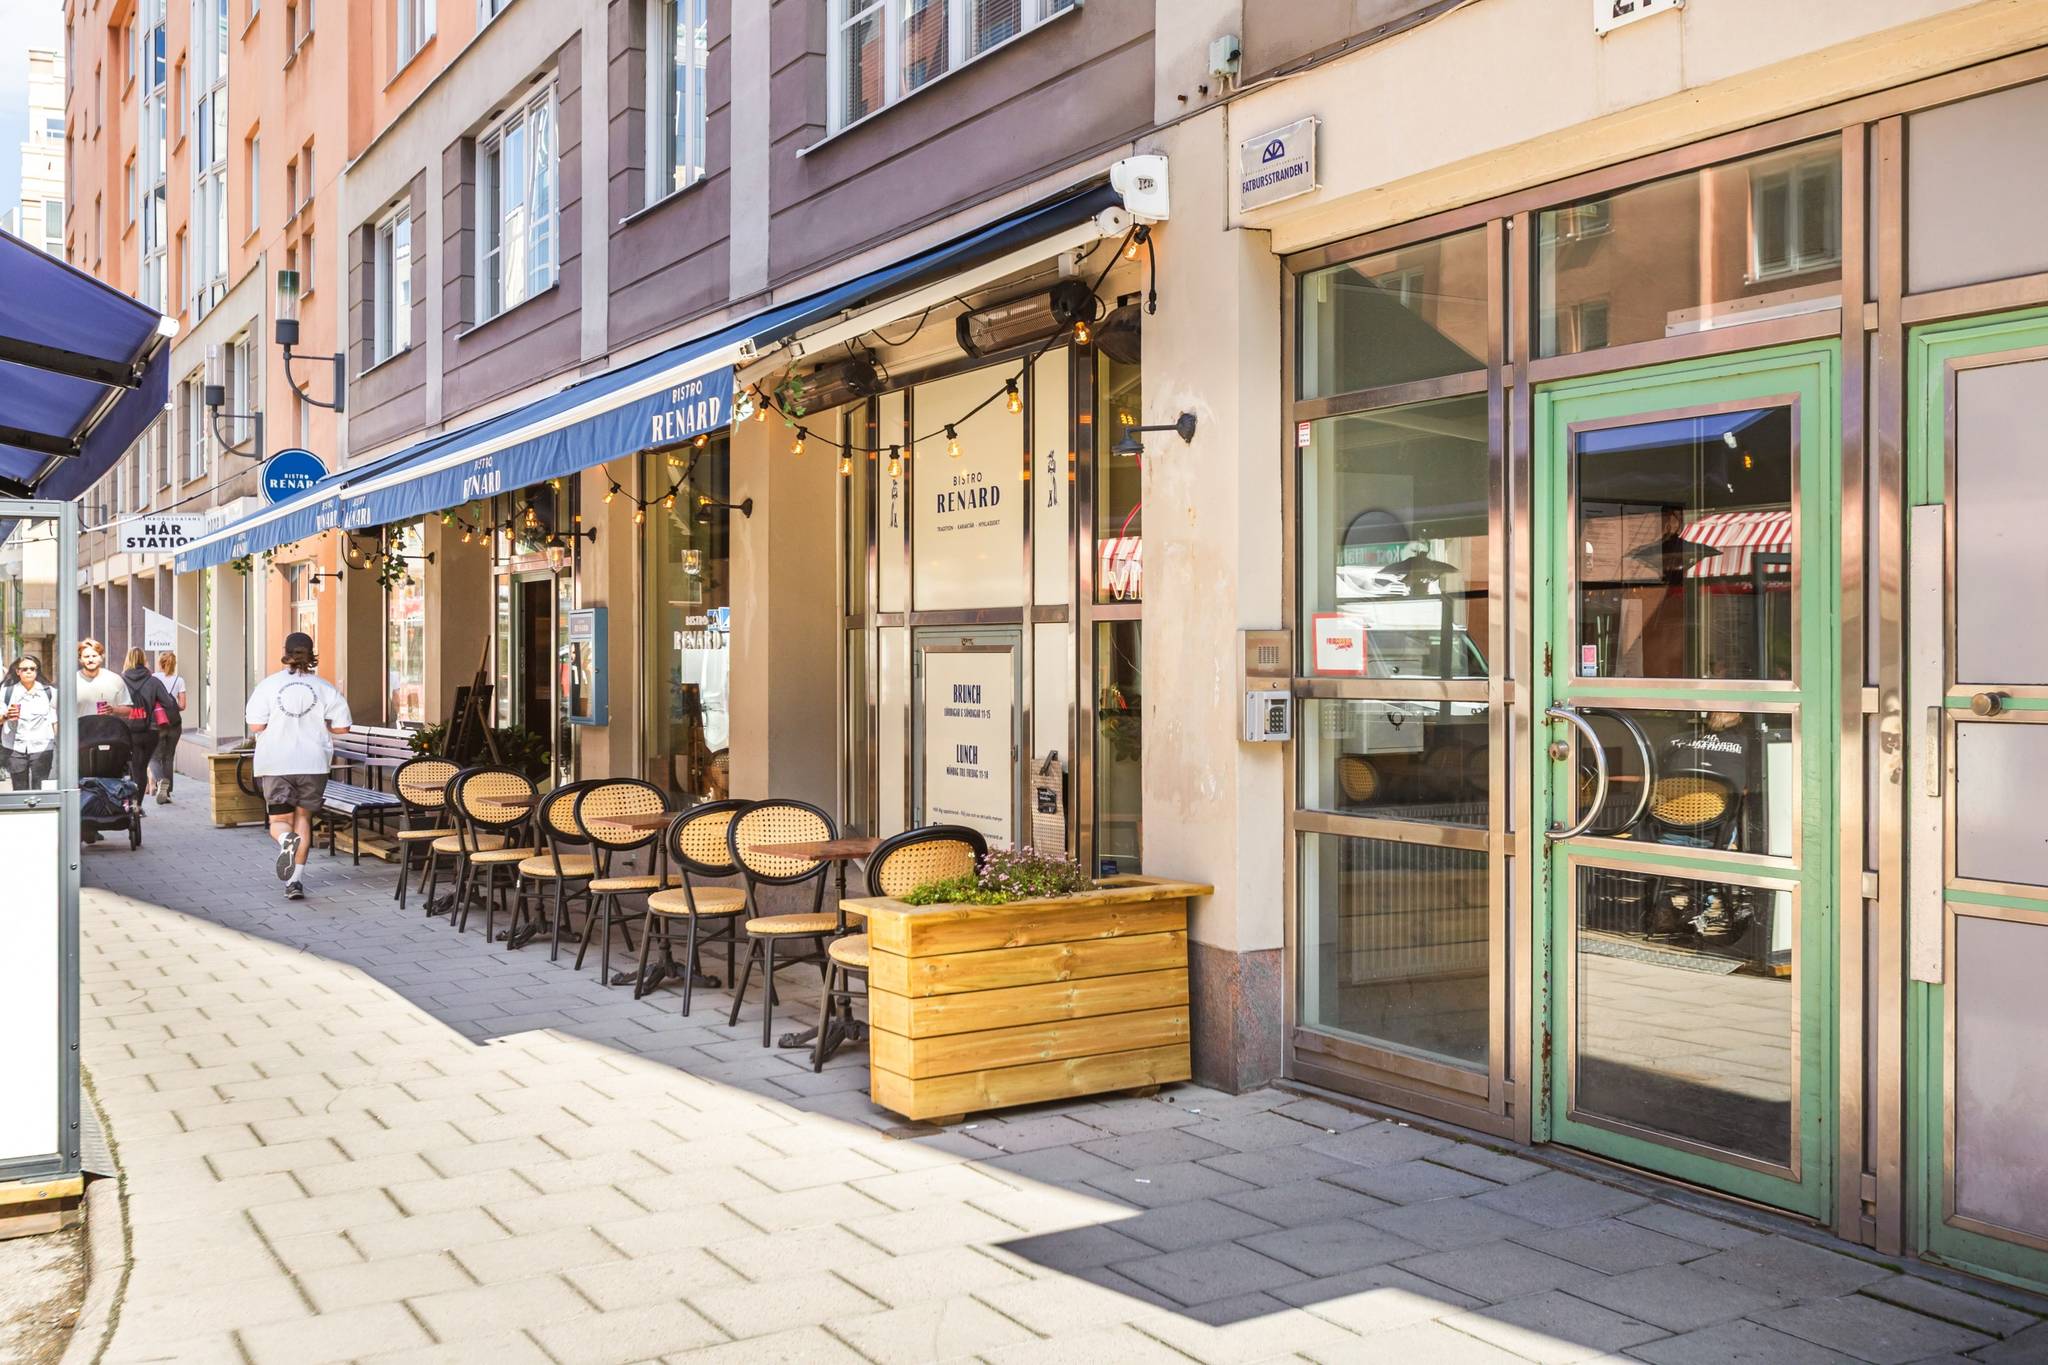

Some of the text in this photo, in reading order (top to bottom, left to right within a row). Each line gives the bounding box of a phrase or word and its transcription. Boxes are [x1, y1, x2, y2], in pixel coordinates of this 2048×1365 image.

[1242, 163, 1303, 193] FATBURSSTRANDEN
[1305, 160, 1309, 173] 1
[672, 380, 703, 404] BISTRO
[651, 396, 720, 443] RENARD
[269, 479, 319, 489] RENAR
[953, 471, 983, 486] BISTRO
[936, 486, 1000, 513] RENARD
[145, 521, 182, 535] HÅR
[673, 630, 723, 650] RENARD
[953, 684, 981, 704] BRUNCH
[956, 743, 978, 764] LUNCH
